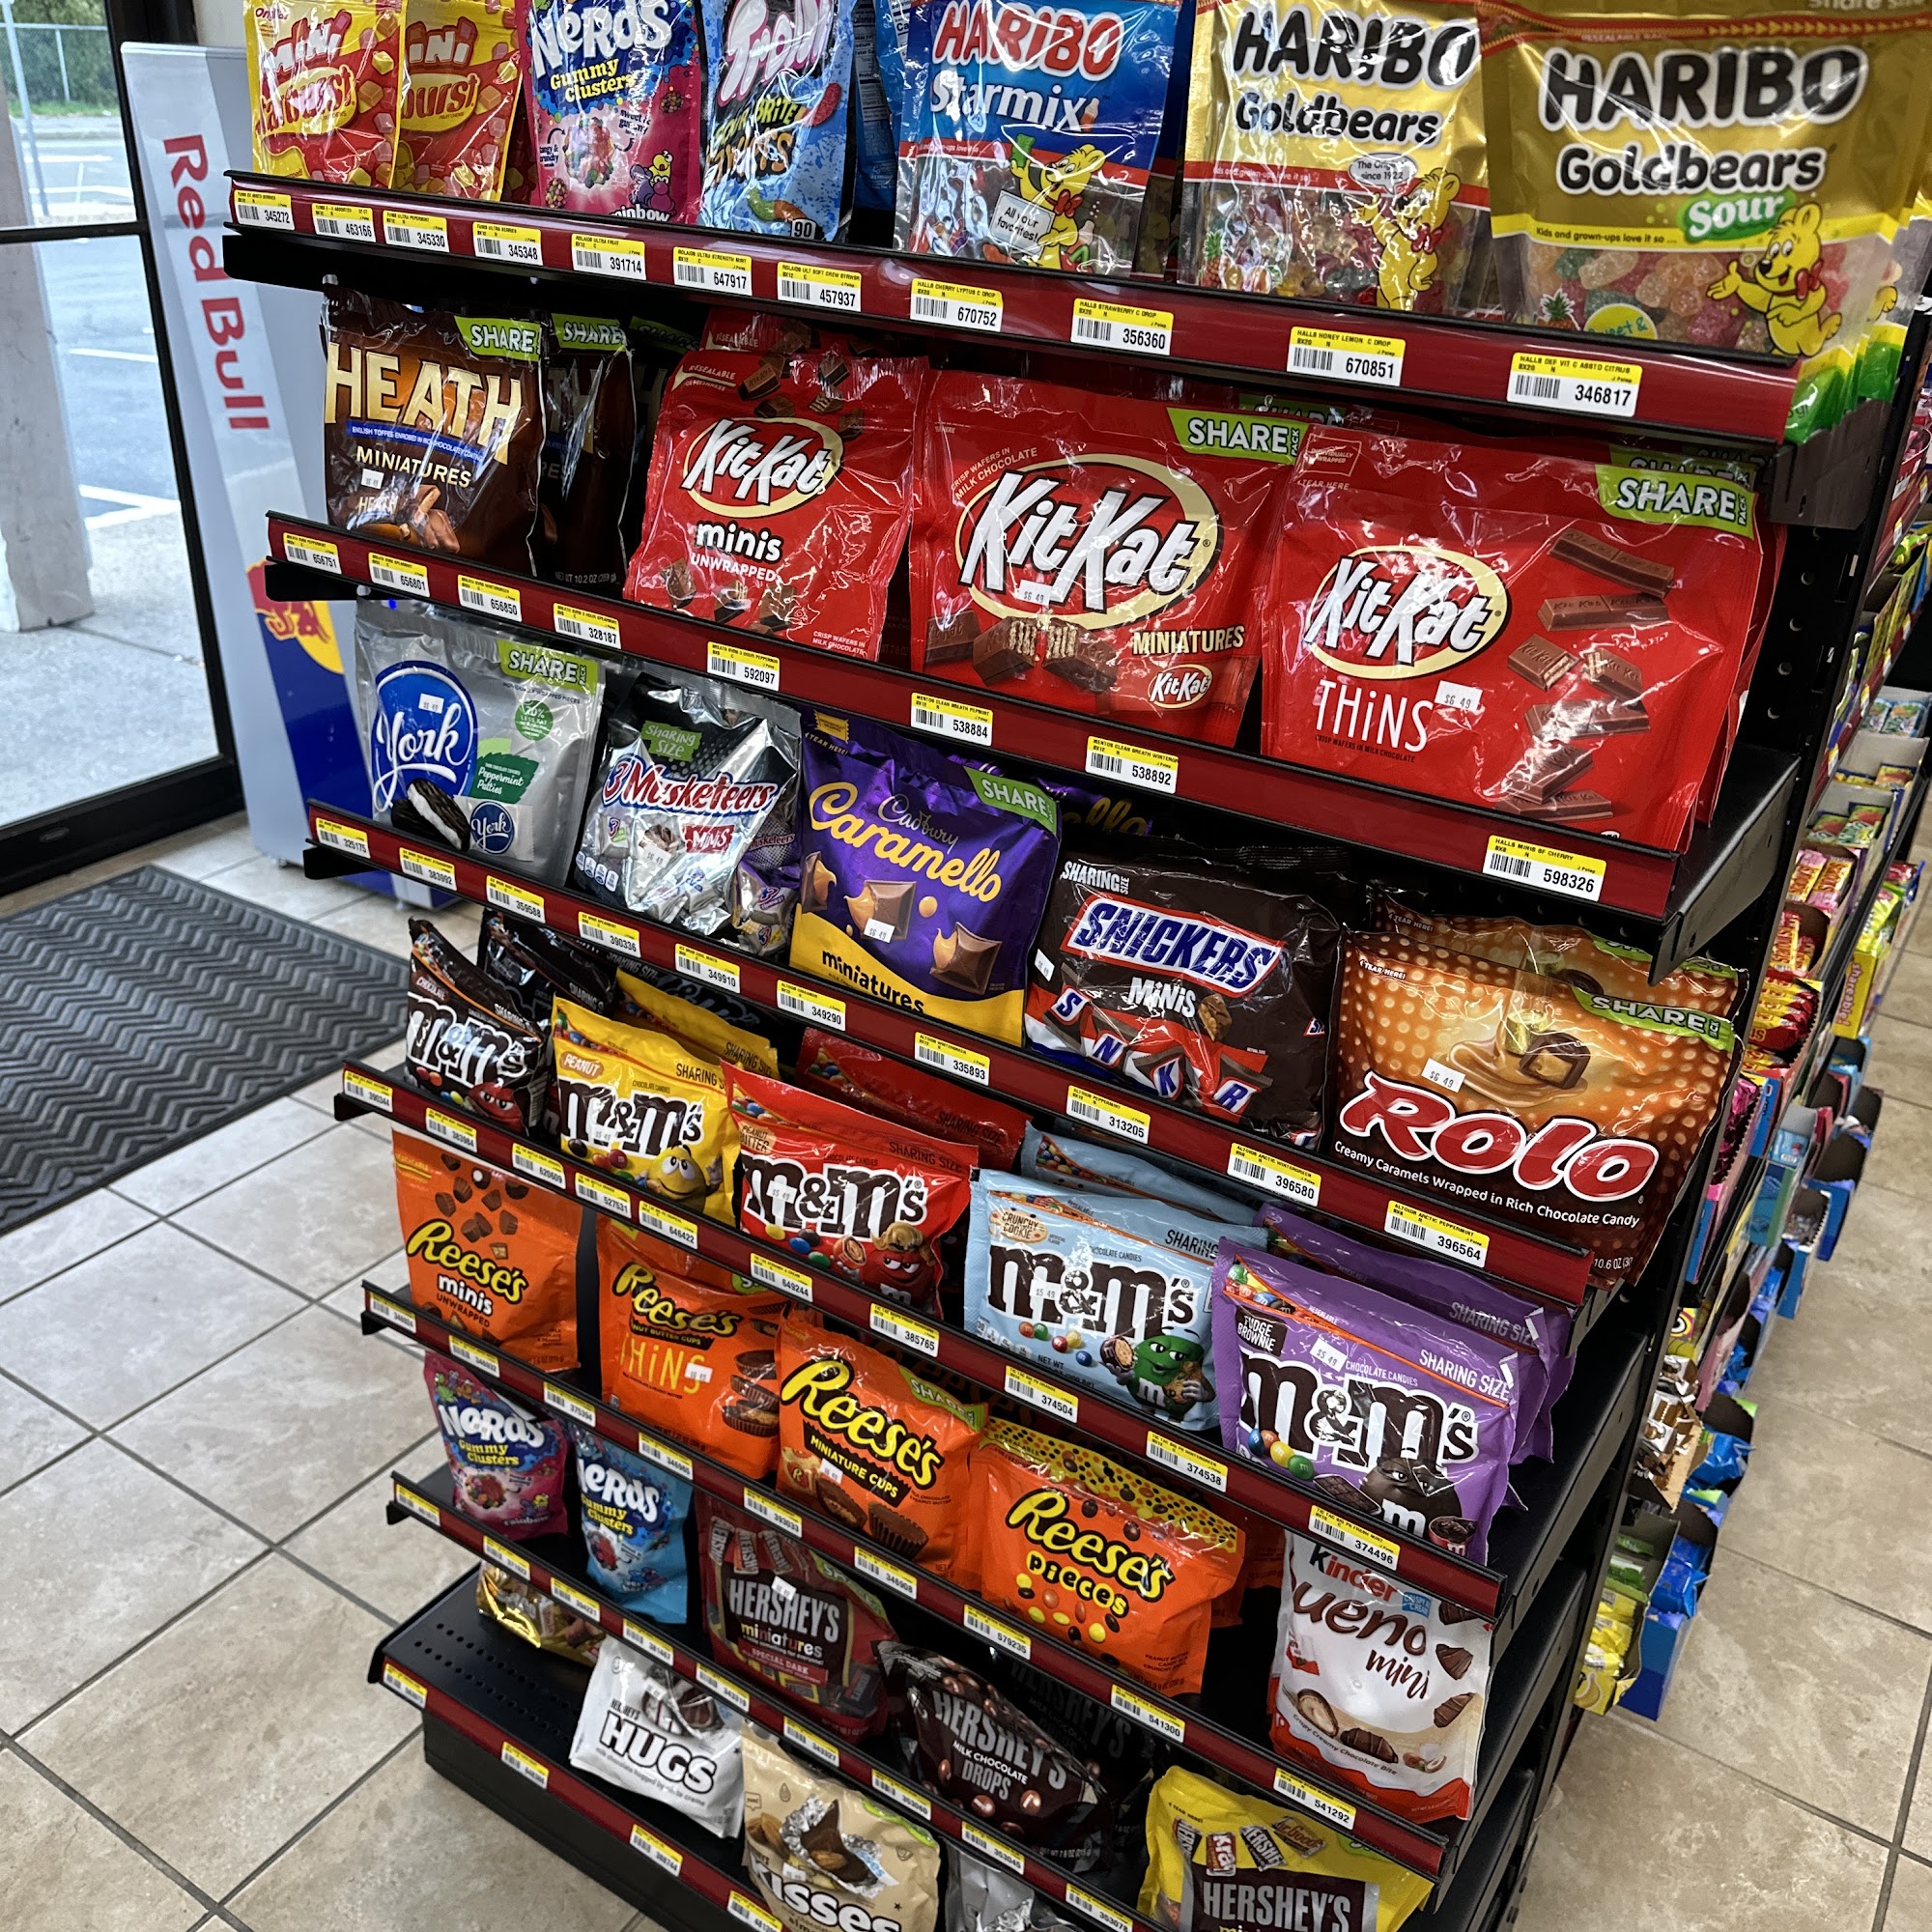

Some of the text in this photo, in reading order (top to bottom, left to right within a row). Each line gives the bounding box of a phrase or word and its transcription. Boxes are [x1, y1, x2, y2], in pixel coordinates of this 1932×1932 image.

[933, 3, 1123, 76] HARIBO
[1233, 9, 1478, 88] HARIBO
[550, 58, 619, 91] Gummy
[565, 73, 635, 102] Clusters
[1543, 47, 1864, 128] HARIBO
[930, 71, 1083, 133] Starmix
[1235, 91, 1439, 146] Goldbears
[1358, 160, 1373, 170] The
[1361, 171, 1382, 182] since
[1559, 144, 1823, 193] Goldbears
[264, 209, 291, 224] 345272
[1004, 205, 1017, 219] All
[1688, 193, 1786, 240] Sour
[345, 222, 373, 239] 463166
[416, 230, 445, 248] 345330
[793, 221, 812, 239] 90
[996, 216, 1038, 242] favorites!
[1536, 226, 1651, 243] Kids and grown-ups love it
[508, 242, 538, 261] 345348
[610, 256, 642, 273] 391714
[163, 134, 270, 430] Red Bull
[713, 270, 747, 290] 647917
[819, 288, 856, 307] 457937
[957, 306, 997, 327] 670752
[470, 324, 534, 354] SHARE
[562, 322, 624, 346] SHARE
[1122, 327, 1166, 350] 356360
[1319, 332, 1340, 341] HONEY
[1346, 357, 1394, 379] 670851
[325, 342, 523, 465] HEATH
[1575, 384, 1632, 407] 346817
[1188, 416, 1301, 456] SHARE PACK
[355, 445, 473, 489] MINIATURES
[681, 418, 831, 505] KitKat
[969, 452, 1001, 475] WAFERS
[977, 446, 1038, 482] CHOCOLATE
[1326, 481, 1350, 491] HERE
[1616, 476, 1748, 527] SHARE PACK
[696, 522, 782, 561] minis
[959, 471, 1201, 612] KitKat
[313, 553, 337, 569] 656751
[690, 553, 778, 582] UNWRAPPED
[400, 575, 426, 591] 656801
[490, 597, 518, 616] 656850
[1303, 557, 1493, 667] KitKat
[588, 627, 618, 644] 328187
[811, 637, 827, 647] MILK
[812, 630, 857, 646] CRISP WAFERS
[1132, 626, 1245, 656] MINIATURES
[507, 650, 579, 684] SHARE
[743, 662, 776, 685] 592097
[1444, 694, 1471, 709] $6 49
[952, 719, 988, 739] 538884
[476, 780, 502, 795] Patties
[477, 766, 525, 787] Peppermint
[628, 763, 775, 812] Musketeers
[1131, 764, 1172, 785] 538892
[981, 778, 1048, 818] SHARE
[877, 793, 959, 854] Cadbury
[809, 781, 1002, 902] Caramello
[1062, 860, 1121, 894] SHARING
[1543, 869, 1595, 893] 598326
[1072, 901, 1278, 988] SNICKERS
[707, 969, 737, 988] 349910
[821, 950, 925, 1014] miniatures
[811, 1006, 841, 1025] 349290
[1591, 995, 1707, 1034] SHARE
[563, 1053, 601, 1076] PEANUT
[724, 1041, 758, 1067] SHARING
[675, 1063, 718, 1087] SHARING
[952, 1060, 986, 1080] 335893
[1430, 1070, 1454, 1089] $6 49
[742, 1123, 769, 1140] PEANUT
[1109, 1116, 1145, 1138] 313205
[888, 1141, 936, 1167] SHARING
[1275, 1175, 1315, 1200] 396580
[1334, 1140, 1640, 1229] Creamy Caramels Wrapped in Rich Chocolate Candy
[603, 1196, 629, 1213] 527531
[1001, 1211, 1038, 1230] CRUNCHY
[1003, 1222, 1033, 1240] COOKIE
[1118, 1249, 1143, 1263] CANDIES
[1165, 1230, 1220, 1259] SHARING
[1437, 1235, 1481, 1261] 396564
[405, 1219, 528, 1302] Reese's
[1593, 1256, 1612, 1269] 10.6
[438, 1274, 494, 1317] minis
[614, 1264, 741, 1336] Reese's
[781, 1279, 810, 1297] 649244
[988, 1247, 1195, 1339] m&m's
[436, 1293, 491, 1328] UNWRAPPED
[1450, 1301, 1509, 1337] SHARING
[1236, 1322, 1277, 1351] BROWNIE
[1243, 1315, 1273, 1335] FUDGE
[904, 1329, 935, 1351] 385765
[1037, 1354, 1051, 1365] NET
[1346, 1360, 1418, 1387] CHOCOLATE CANDIES
[1419, 1349, 1511, 1402] SHARING SIZE
[1041, 1394, 1073, 1416] 374504
[1240, 1354, 1476, 1469] m&m's
[781, 1357, 943, 1488] Reese's
[458, 1439, 508, 1458] Gummy
[467, 1451, 520, 1466] Clusters
[810, 1435, 899, 1498] MINIATURE CUPS
[1186, 1463, 1222, 1486] 374538
[586, 1510, 634, 1536] Clusters
[1007, 1490, 1173, 1599] Reese's
[1354, 1539, 1393, 1564] 374496
[728, 1577, 840, 1643] HERSHEY'S
[741, 1623, 823, 1659] miniatures
[752, 1648, 810, 1675] SPECIAL DARK
[1365, 1649, 1432, 1700] mini
[1148, 1714, 1180, 1738] 541300
[599, 1709, 719, 1795] HUGS
[932, 1690, 1067, 1790] HERSHEY'S
[1312, 1725, 1339, 1752] Creamy
[1340, 1747, 1380, 1772] Chocolate
[952, 1740, 1029, 1785] MILK CHOCOLATE
[962, 1759, 1012, 1801] DROPS
[1314, 1798, 1350, 1825] 541292
[1203, 1881, 1351, 1932] HERSHEY'S
